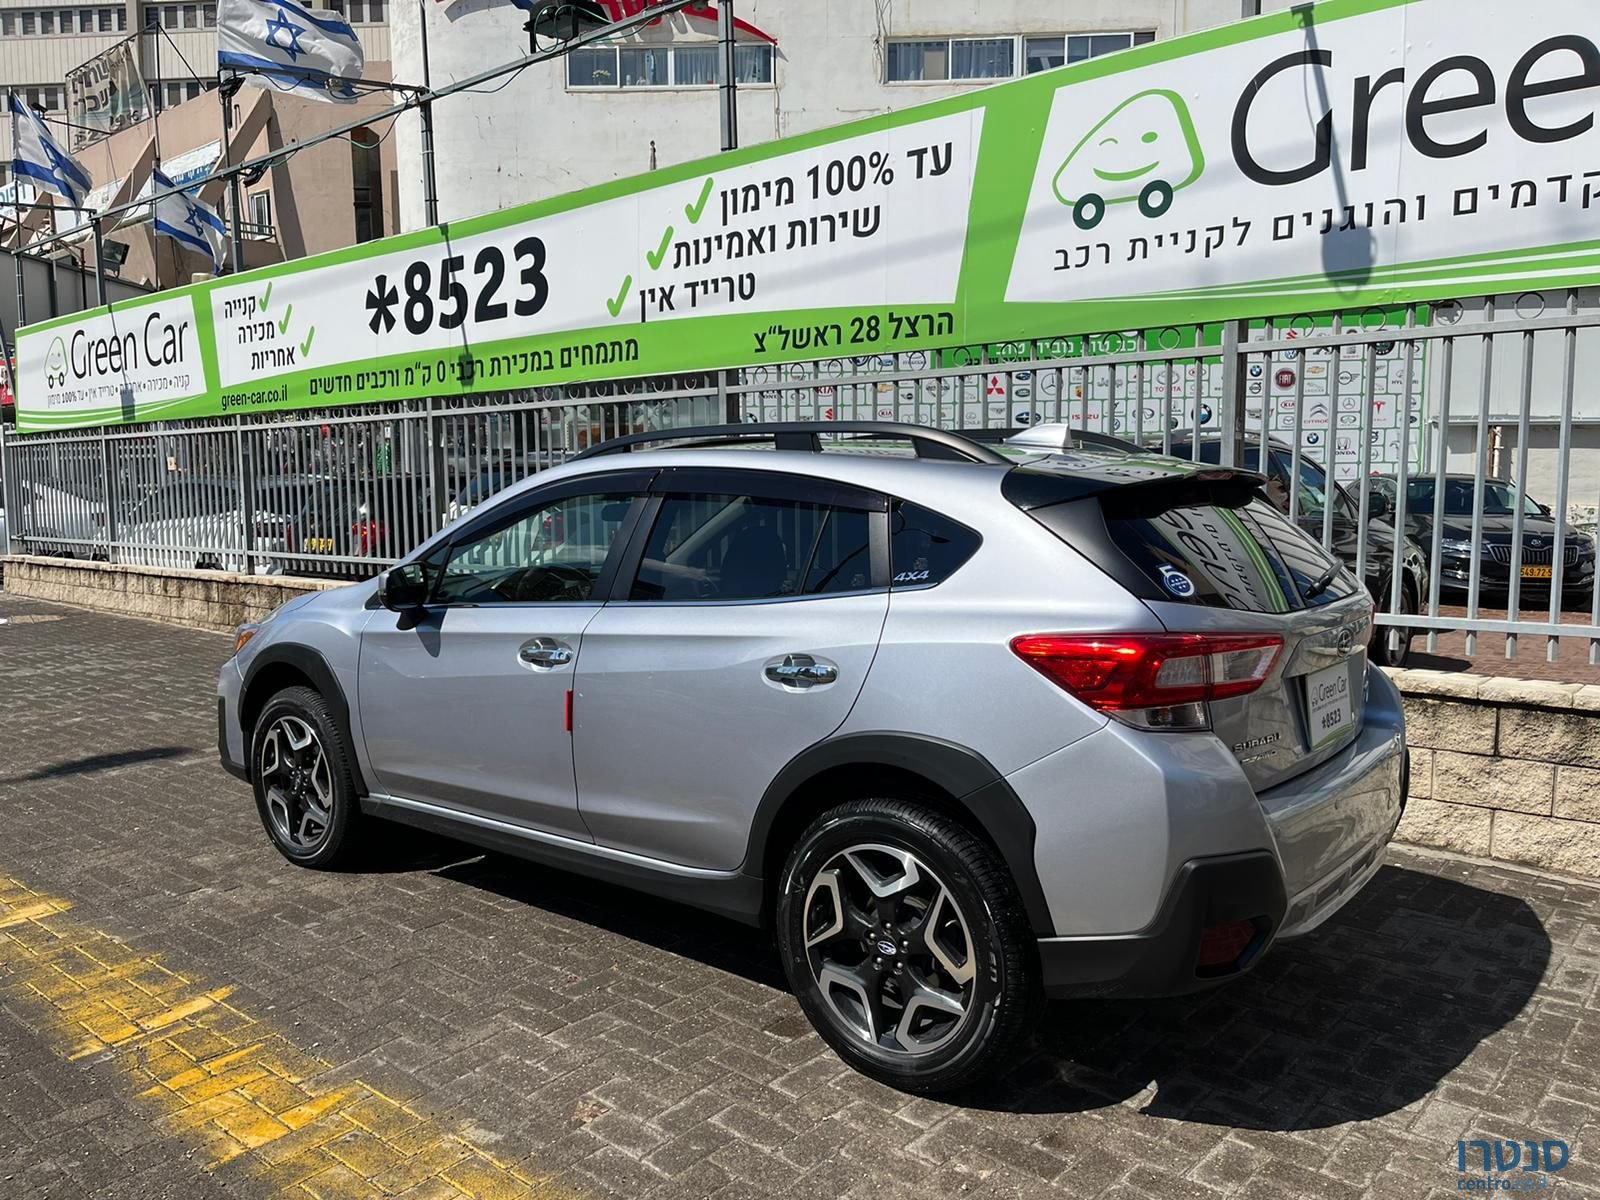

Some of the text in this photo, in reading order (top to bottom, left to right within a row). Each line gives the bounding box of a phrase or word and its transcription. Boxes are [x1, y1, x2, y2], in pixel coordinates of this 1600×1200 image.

[720, 142, 953, 226] עד 100% מימון
[673, 205, 881, 270] שירות ואמינות
[1272, 194, 1426, 241] והוגנים
[1054, 242, 1110, 271] רכב
[1127, 217, 1251, 261] לקניית
[224, 295, 256, 320] קנייה
[639, 272, 756, 323] טרייד אין
[71, 312, 188, 380] Green Car
[238, 320, 275, 344] מכירה
[754, 312, 953, 353] הרצל 28 ראשל"צ
[251, 346, 296, 370] אחריות
[310, 338, 639, 396] מתמחים במכירת רכבי 0 ק"מ ורכבים חדשים
[221, 384, 288, 411] green-car.co.il
[1318, 675, 1348, 702] Green Car
